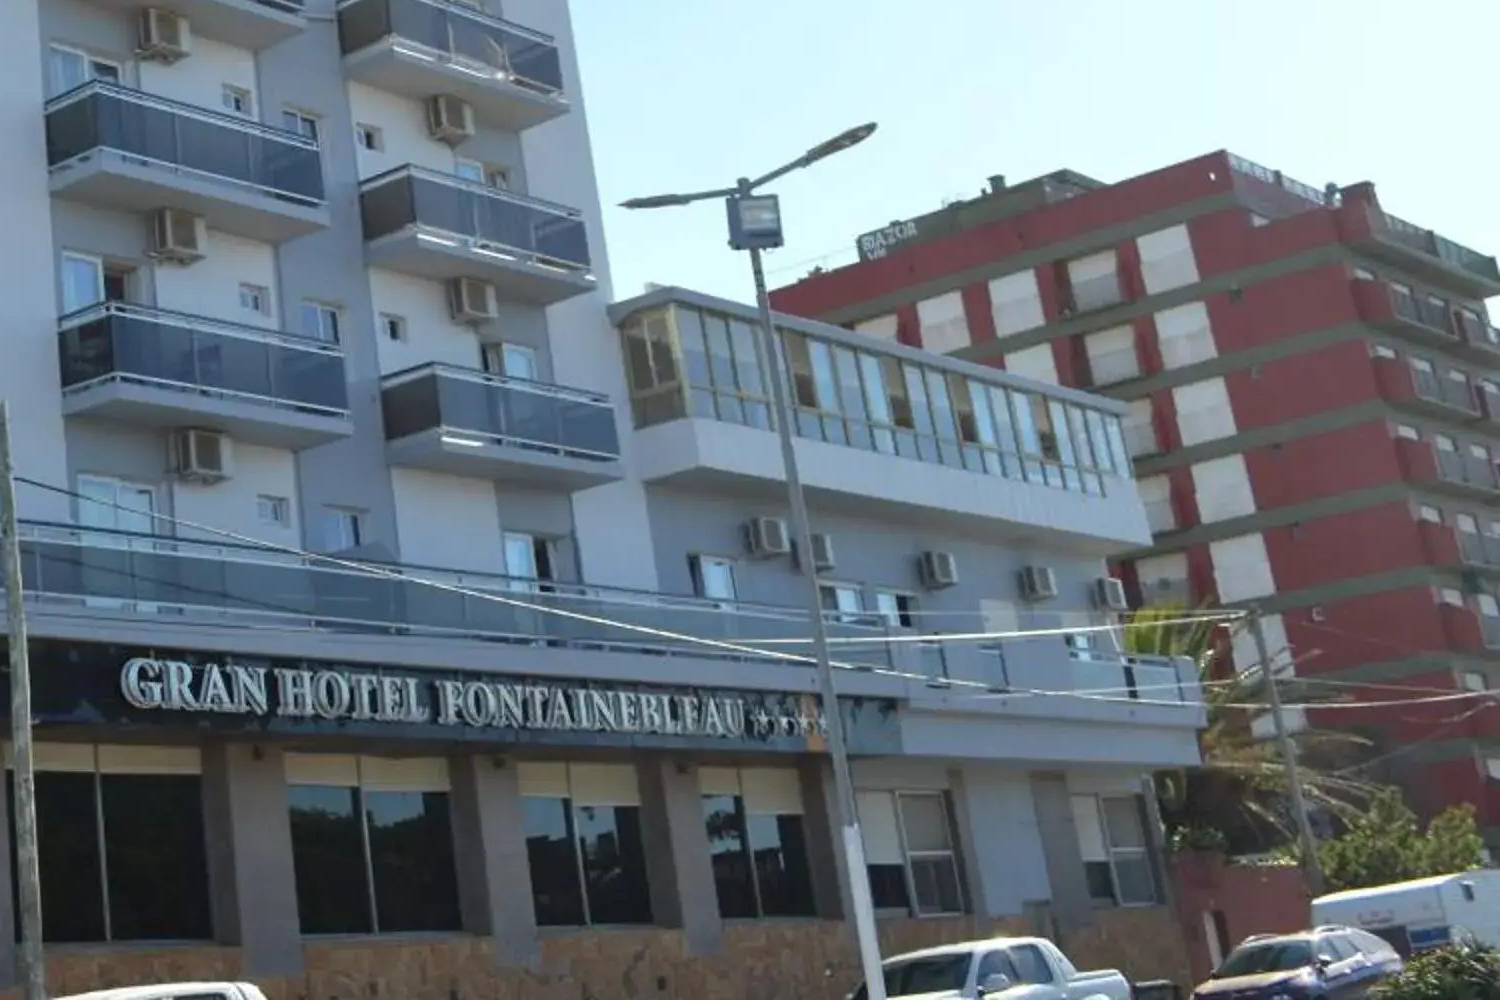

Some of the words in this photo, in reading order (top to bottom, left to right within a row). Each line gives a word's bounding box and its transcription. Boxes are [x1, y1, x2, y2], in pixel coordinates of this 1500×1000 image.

[120, 657, 269, 716] GRAN
[273, 667, 429, 722] HOTEL
[434, 679, 747, 737] FONTAINEBLEAU
